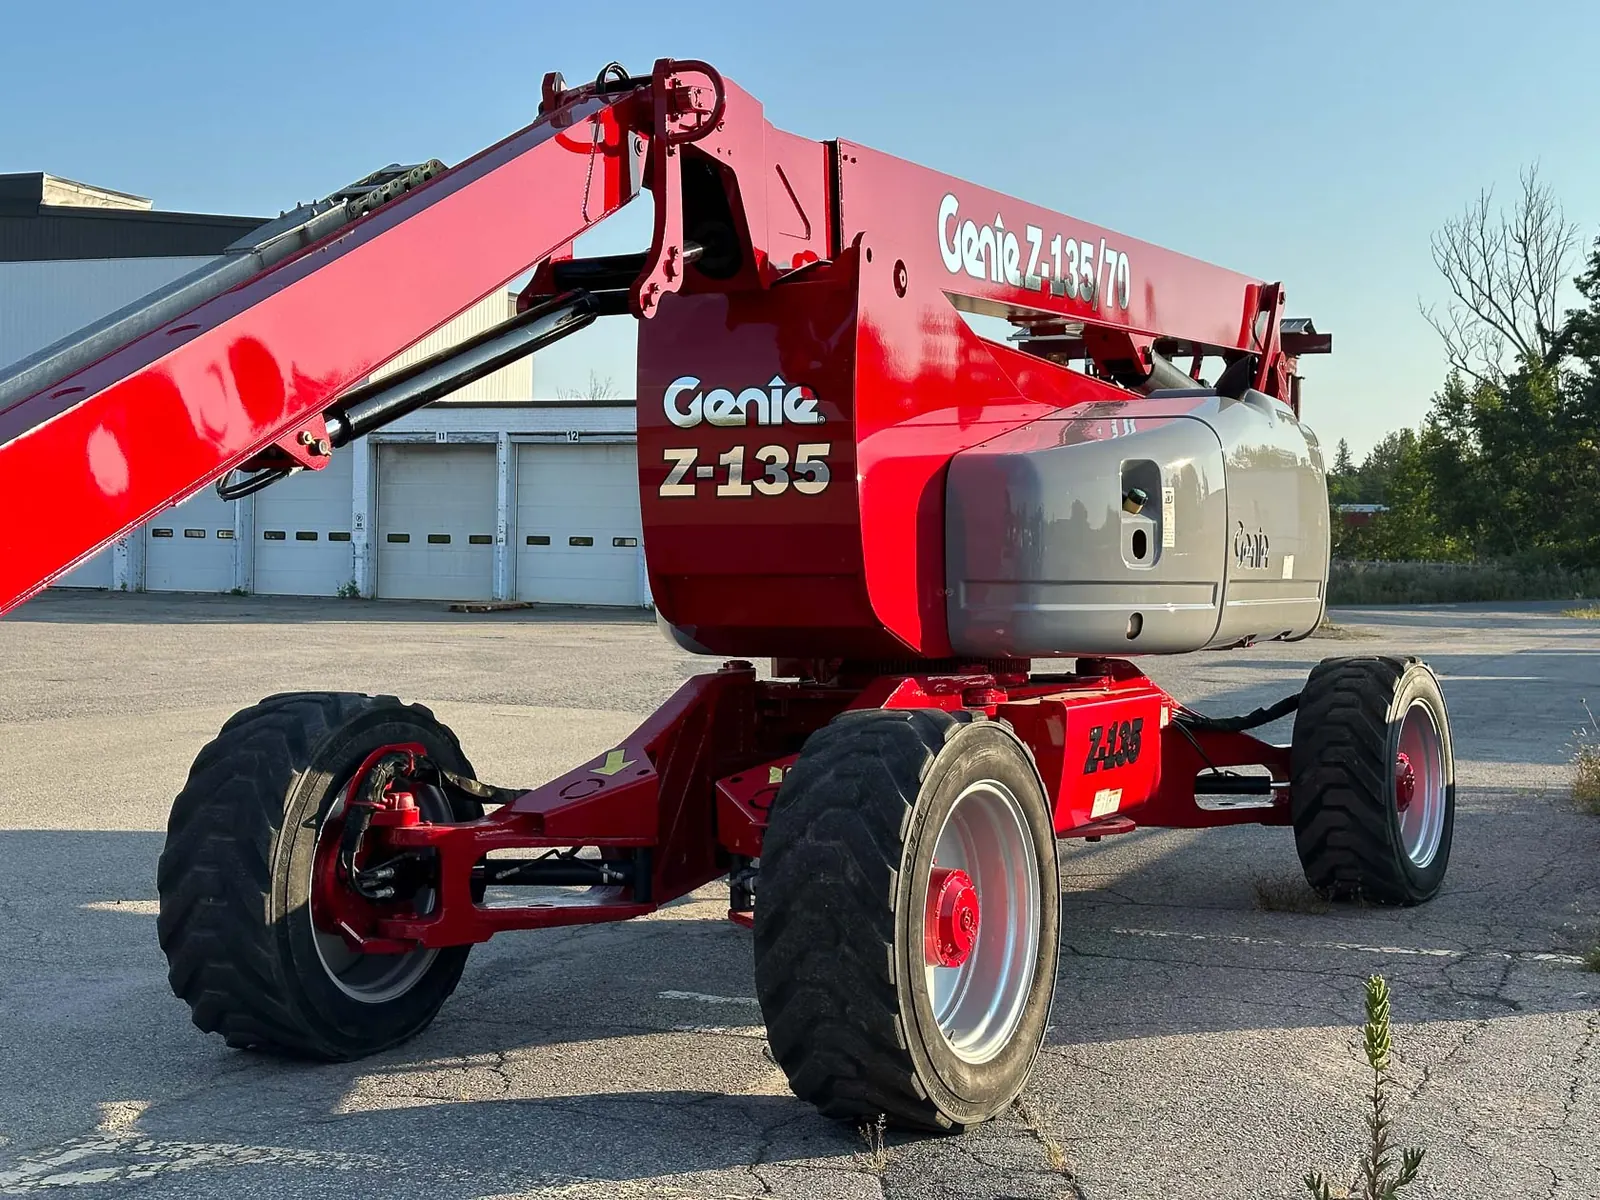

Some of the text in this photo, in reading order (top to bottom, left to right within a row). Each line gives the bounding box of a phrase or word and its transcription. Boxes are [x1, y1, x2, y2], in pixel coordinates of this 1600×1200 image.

[938, 192, 1131, 312] Genie Z-135/70
[663, 375, 820, 428] Genie
[567, 430, 578, 441] 12
[659, 443, 831, 497] Z-135
[1083, 717, 1144, 775] Z-135
